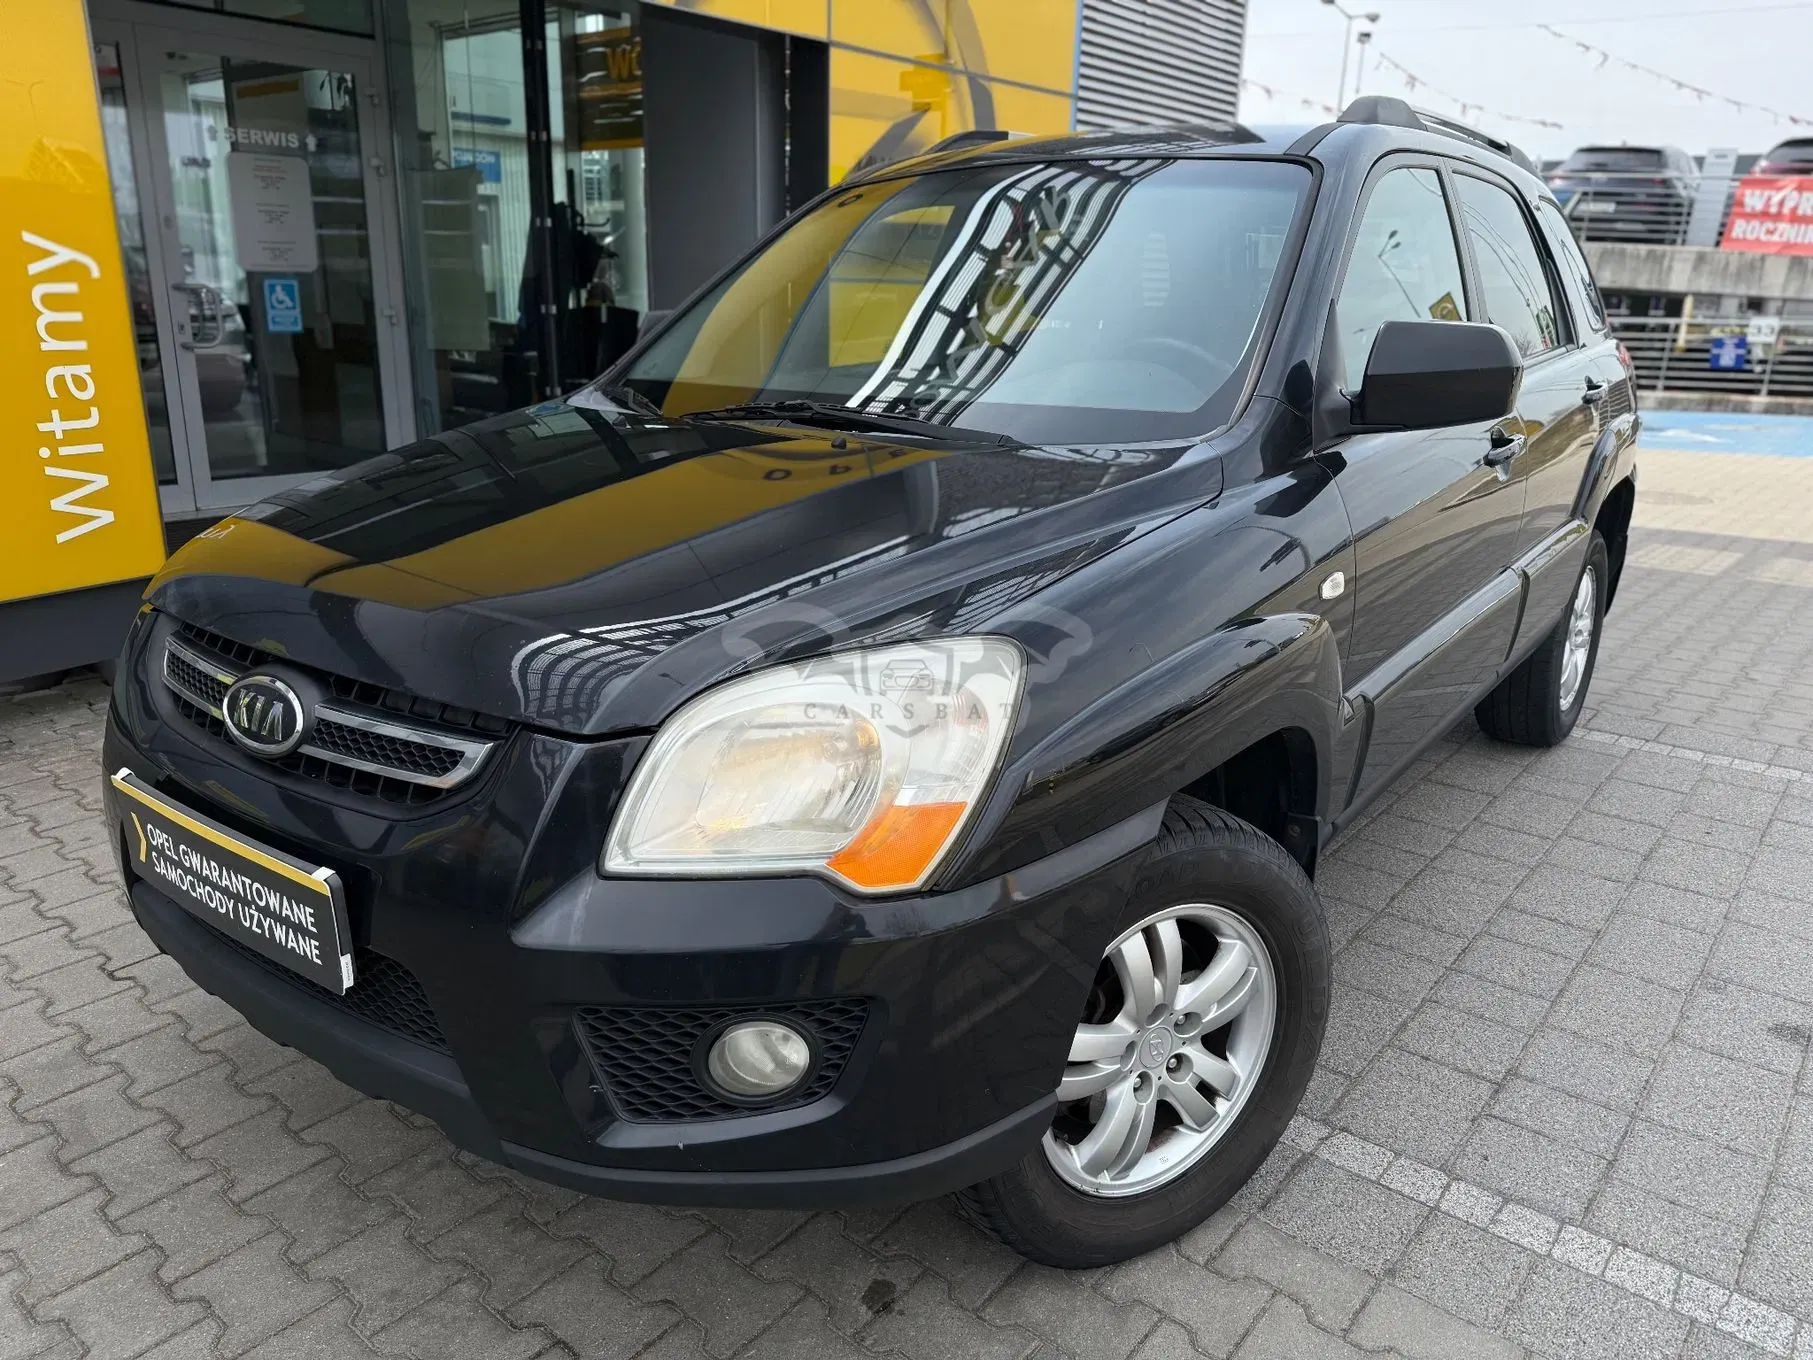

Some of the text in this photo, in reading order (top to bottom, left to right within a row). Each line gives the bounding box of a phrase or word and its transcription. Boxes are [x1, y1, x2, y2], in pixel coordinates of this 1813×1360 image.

[224, 127, 299, 148] SERWIS
[21, 229, 115, 544] Witamy
[233, 687, 285, 741] KIA
[146, 823, 319, 934] OPEL GWARANTOWANE
[151, 851, 323, 966] SAMOCHODY UŻYWANE
